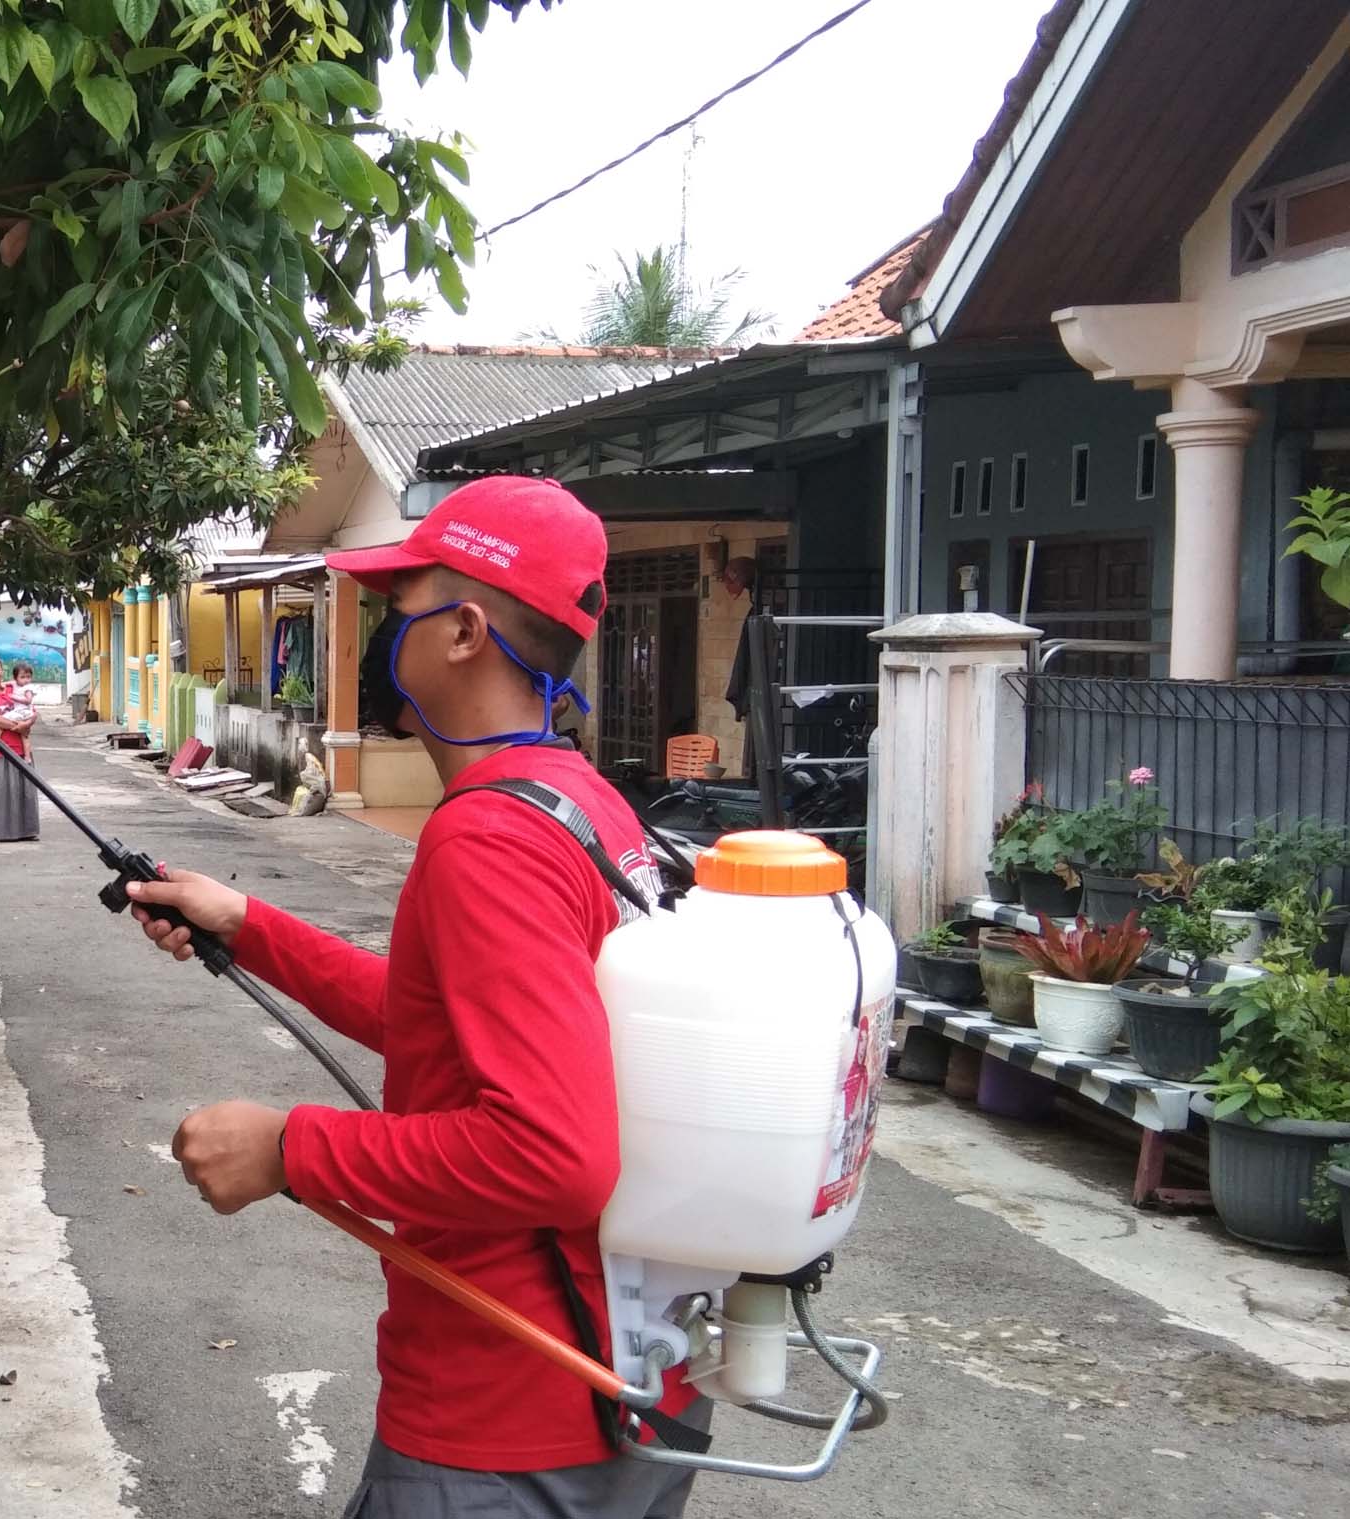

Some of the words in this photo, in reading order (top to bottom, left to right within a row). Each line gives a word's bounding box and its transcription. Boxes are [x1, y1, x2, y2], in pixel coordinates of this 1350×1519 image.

[440, 533, 471, 551] PERIODE
[446, 520, 478, 539] BANDAR
[477, 531, 519, 557] LAMPUNG
